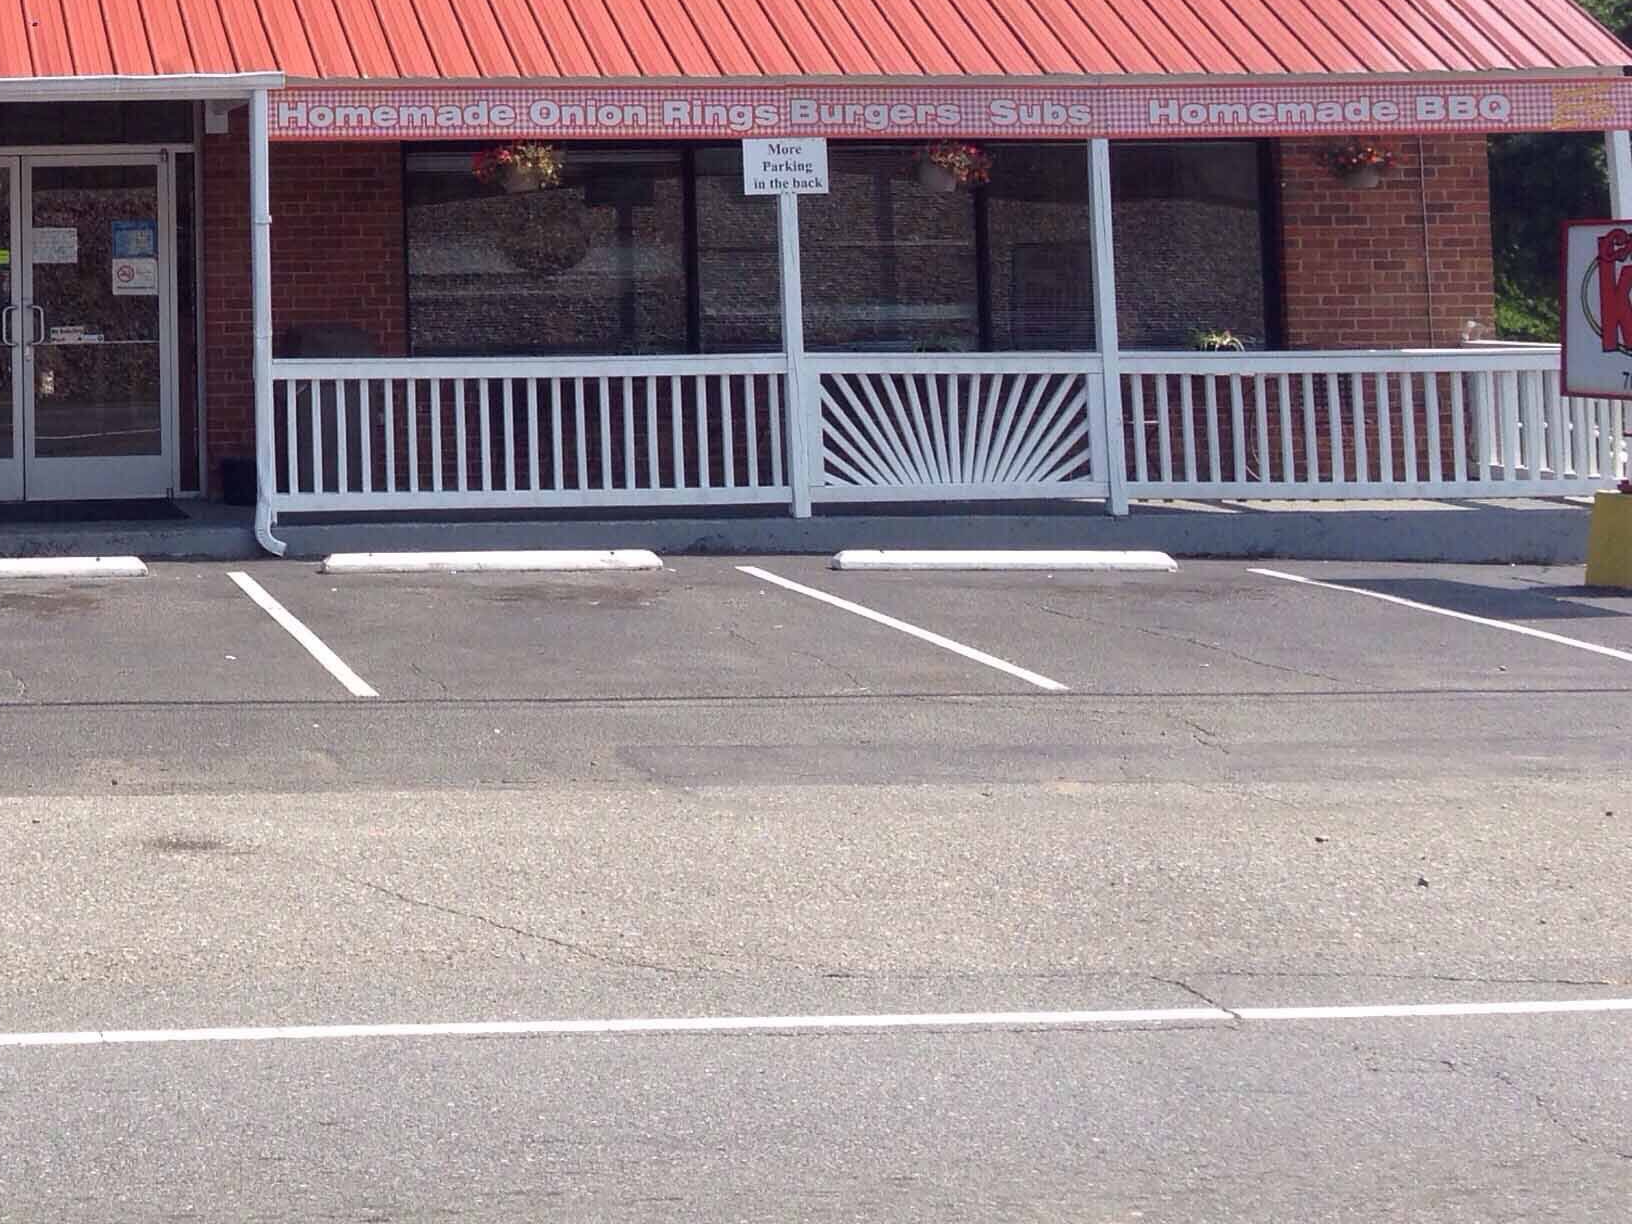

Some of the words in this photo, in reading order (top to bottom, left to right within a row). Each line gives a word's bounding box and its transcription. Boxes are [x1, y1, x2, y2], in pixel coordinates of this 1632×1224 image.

[277, 100, 515, 129] Homemade
[529, 98, 648, 127] Onion
[662, 97, 779, 131] Rings
[789, 99, 962, 130] Burgers
[989, 98, 1093, 127] Subs
[1148, 96, 1400, 125] Homemade
[1415, 93, 1512, 123] BBQ
[768, 143, 802, 155] More
[762, 160, 813, 174] Parking
[753, 178, 766, 189] in
[770, 178, 789, 189] the
[792, 177, 823, 189] back
